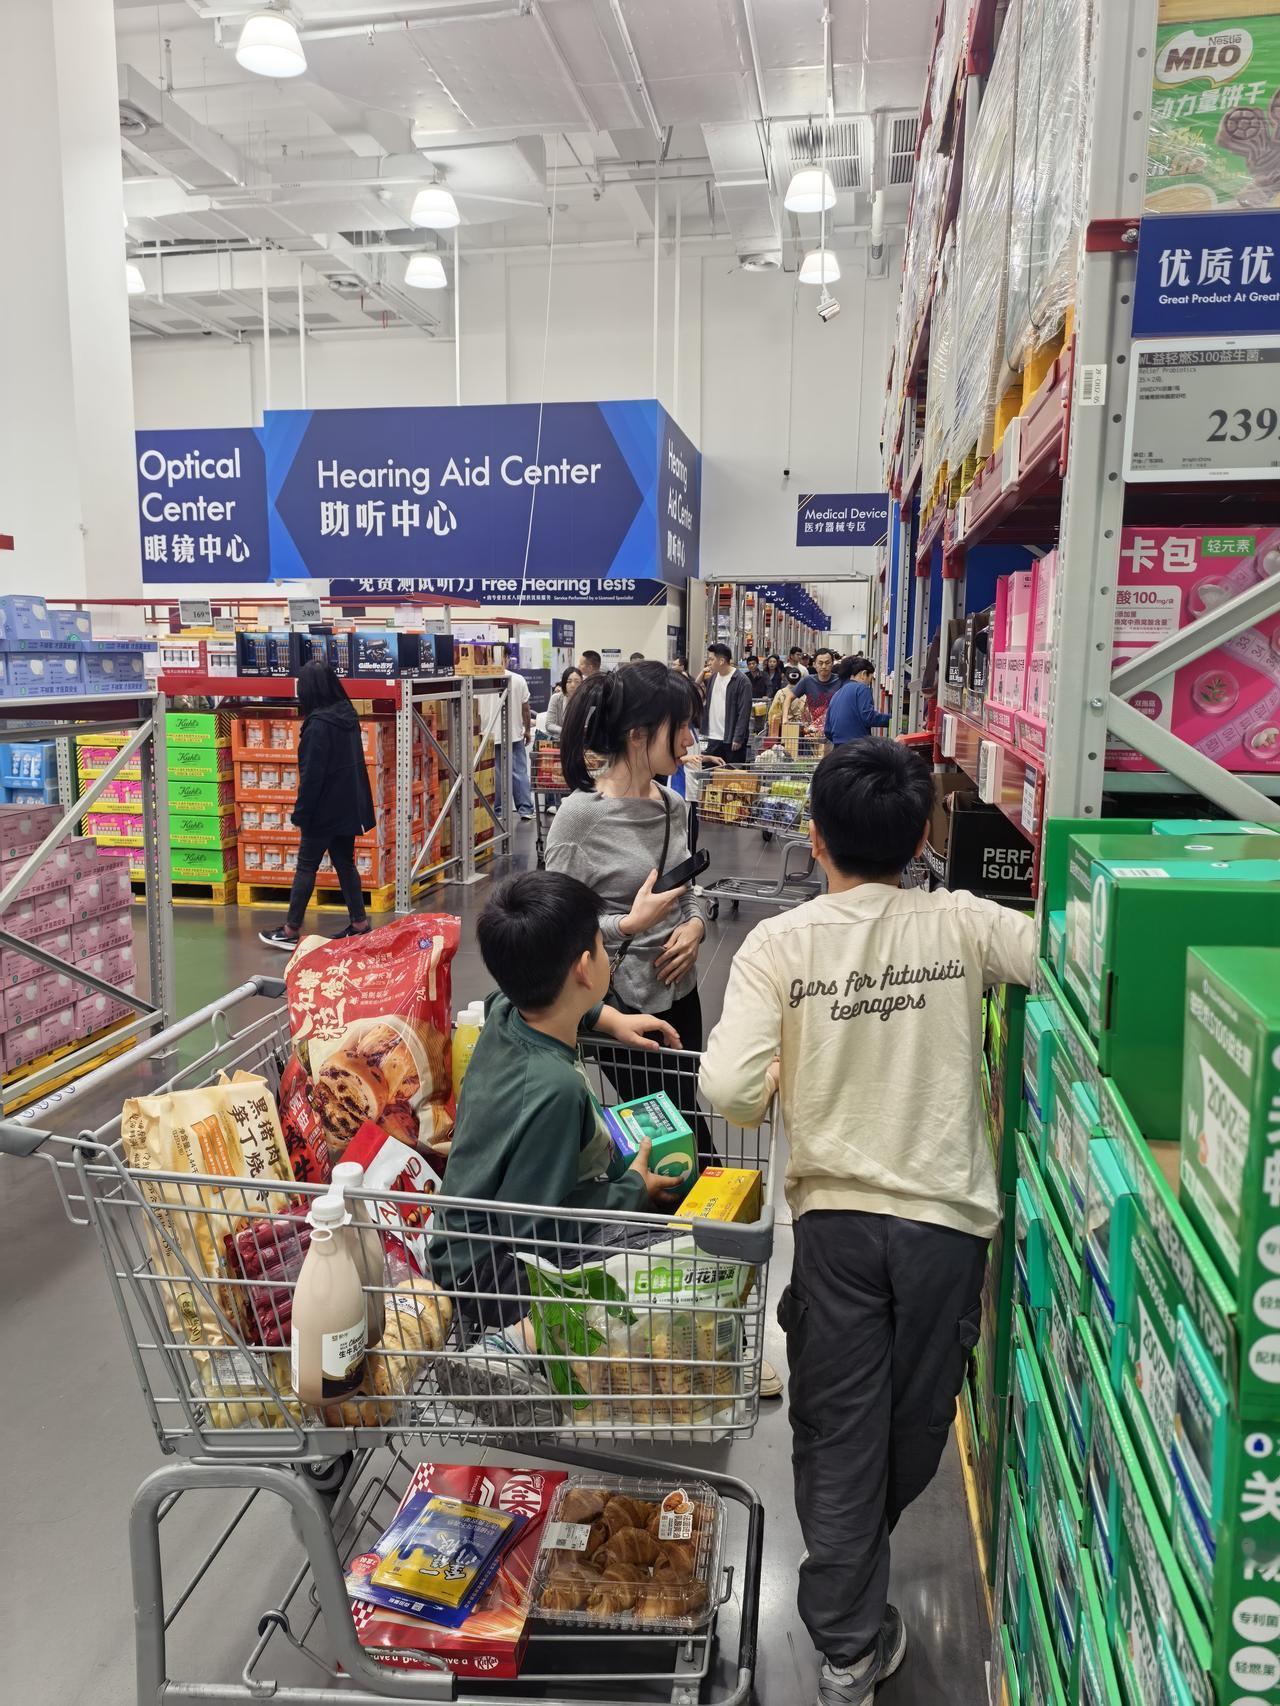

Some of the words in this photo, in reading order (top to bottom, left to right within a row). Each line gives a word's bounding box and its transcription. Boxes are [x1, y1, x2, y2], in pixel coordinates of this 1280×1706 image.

[1163, 45, 1241, 73] MILO
[1158, 294, 1189, 305] Great
[1191, 293, 1231, 304] Product
[1233, 292, 1247, 302] At
[1249, 291, 1280, 302] Great
[139, 447, 241, 487] Optical
[317, 459, 431, 496] Hearing
[439, 456, 491, 487] Aid
[500, 455, 602, 487] Center
[667, 438, 688, 492] Hearing
[141, 492, 236, 522] Center
[319, 500, 458, 538] 助听中心
[667, 488, 678, 520] Aid
[676, 493, 693, 532] Center
[804, 507, 848, 520] Medical
[850, 507, 888, 520] Device
[804, 521, 866, 533] 医疗器械专区
[144, 533, 250, 564] 眼镜中心
[1121, 535, 1198, 574] 卡包
[1207, 540, 1251, 554] 轻元素
[481, 577, 518, 591] Free
[522, 577, 590, 596] Hearing
[597, 577, 636, 591] Tests
[983, 847, 1034, 864] PERF
[844, 970, 877, 997] for
[830, 993, 927, 1022] teenagers
[248, 1097, 282, 1167] 黑猪肉
[500, 1474, 542, 1518] KitKa
